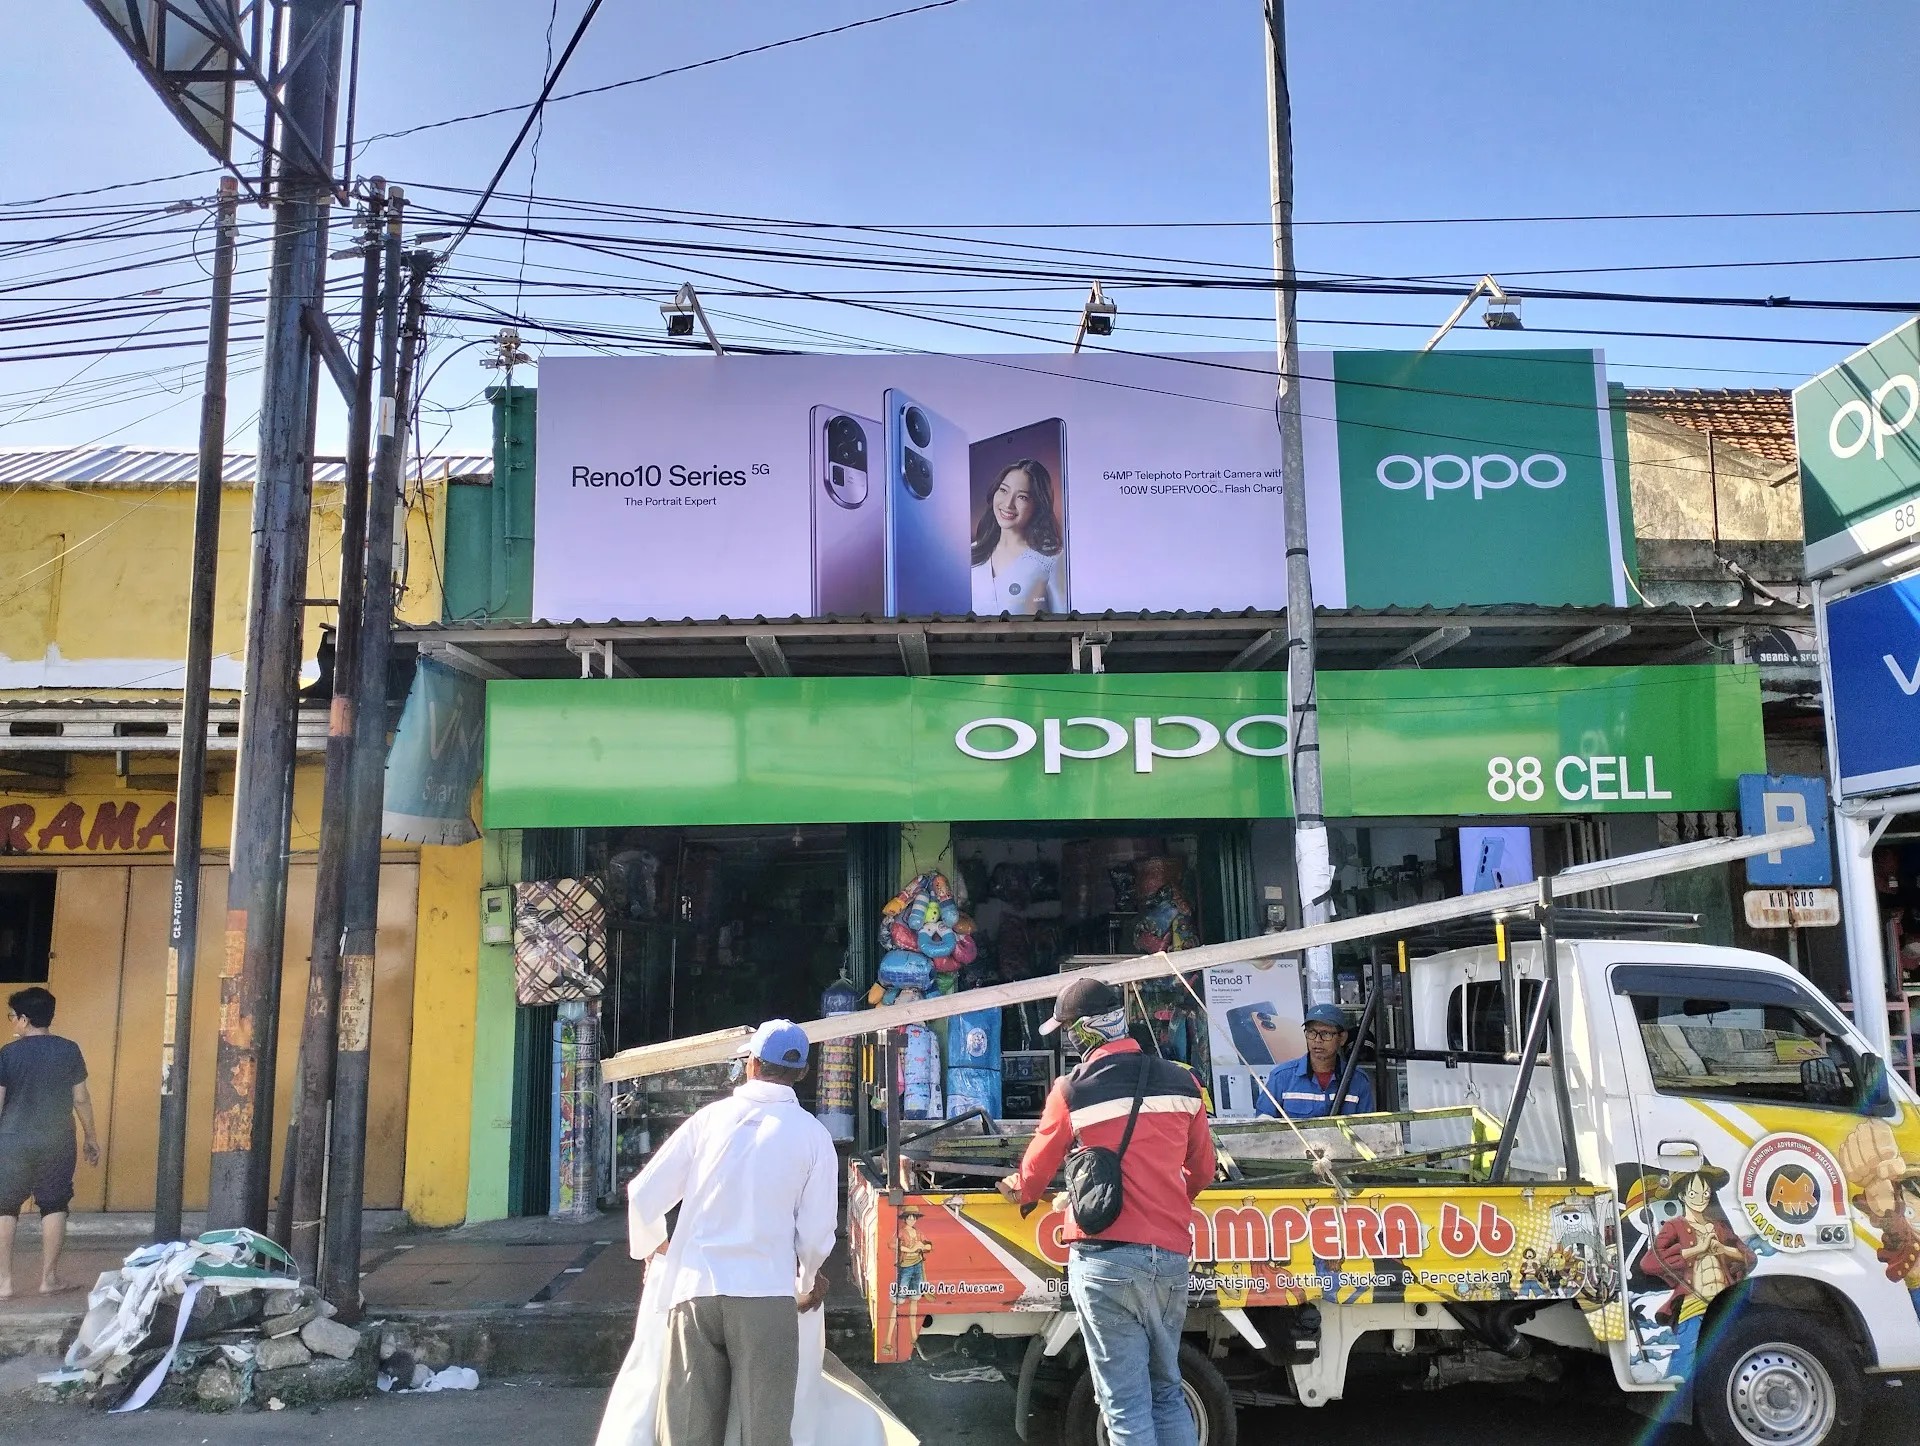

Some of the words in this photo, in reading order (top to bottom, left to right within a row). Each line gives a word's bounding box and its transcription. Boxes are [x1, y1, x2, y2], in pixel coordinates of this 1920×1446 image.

[1829, 374, 1920, 461] op
[572, 465, 662, 487] Reno10
[668, 464, 747, 487] Series
[751, 464, 770, 475] 5G
[1103, 470, 1133, 481] 64MP
[1135, 470, 1182, 482] Telephoto
[1184, 470, 1221, 480] Portrait
[1223, 469, 1261, 479] Camera
[1119, 485, 1148, 495] 100W
[1225, 484, 1250, 493] Flash
[1253, 483, 1283, 495] Charg
[1376, 453, 1567, 500] oppo
[624, 497, 643, 506] The
[646, 497, 682, 506] Portrait
[685, 496, 717, 507] Expert
[955, 715, 1288, 774] oppo
[1487, 756, 1545, 802] 88
[1555, 755, 1673, 802] CELL
[1763, 792, 1808, 864] P
[1210, 975, 1243, 985] Reno8
[1245, 975, 1253, 984] T
[1746, 1164, 1757, 1188] DIGITAL
[1753, 1145, 1774, 1166] PRINTING
[1439, 1201, 1517, 1258] 66
[1744, 1202, 1806, 1248] AMPERA
[1820, 1225, 1847, 1243] 66
[919, 1281, 936, 1294] We
[938, 1281, 956, 1294] Are
[958, 1280, 1005, 1294] Awesome
[1047, 1278, 1070, 1297] Dig
[1276, 1273, 1333, 1291] Cutting
[1340, 1271, 1396, 1288] Sticker
[1403, 1272, 1414, 1285] &
[1420, 1268, 1511, 1286] Percetakan
